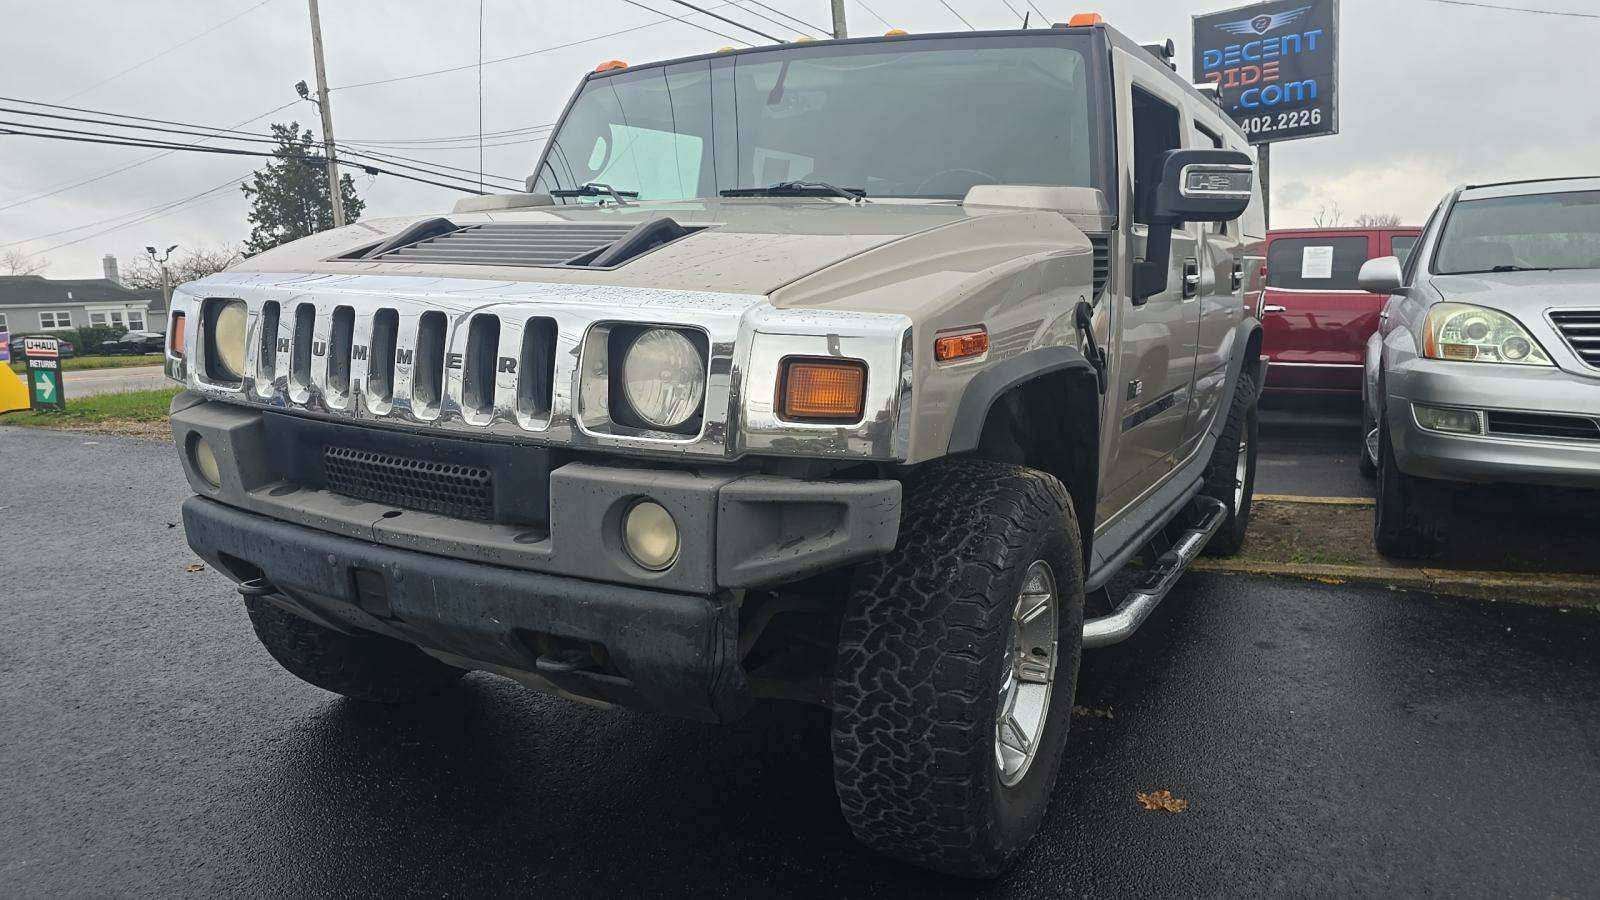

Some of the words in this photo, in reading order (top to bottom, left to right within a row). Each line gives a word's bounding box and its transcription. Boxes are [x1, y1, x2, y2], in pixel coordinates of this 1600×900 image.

[1241, 108, 1322, 134] 402.2226
[26, 341, 56, 350] U-HAUL
[29, 359, 57, 368] RETURNS
[276, 337, 517, 374] HUMMER
